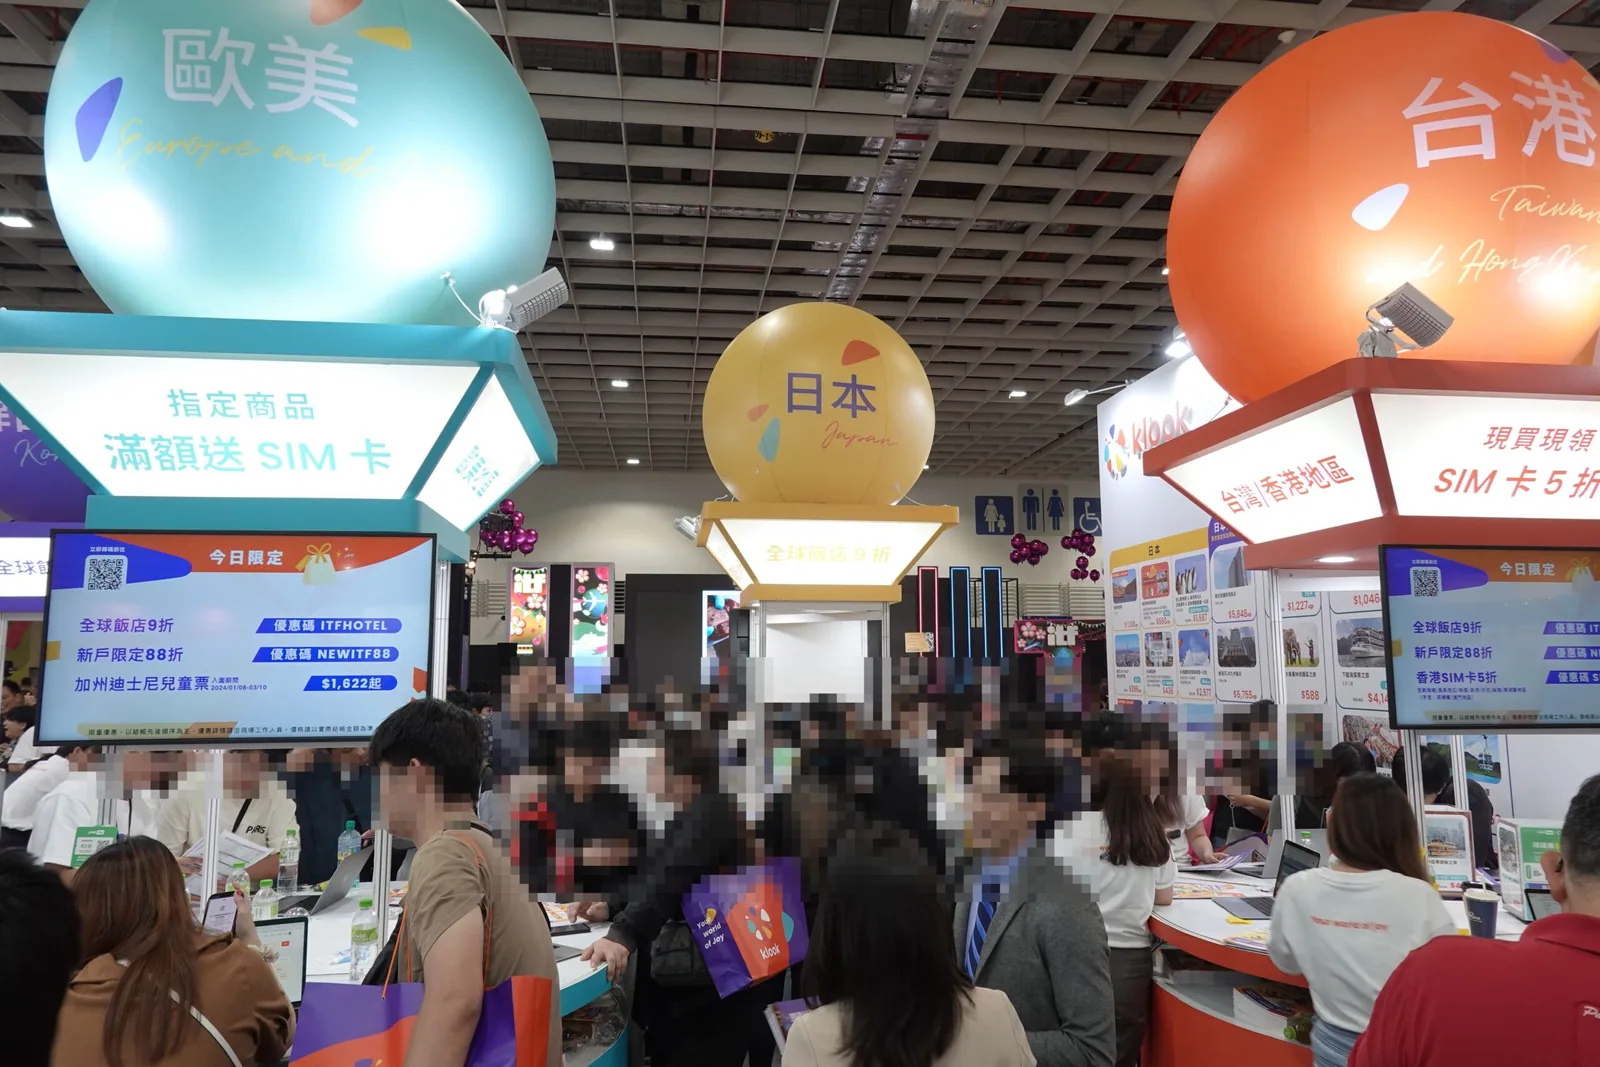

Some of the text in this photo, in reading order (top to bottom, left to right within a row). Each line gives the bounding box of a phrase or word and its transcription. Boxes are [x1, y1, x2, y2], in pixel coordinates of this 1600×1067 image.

[162, 27, 359, 129] 歐美
[1402, 71, 1598, 169] 台港
[115, 116, 263, 171] Europe
[272, 144, 381, 179] and
[787, 373, 877, 419] 日本
[166, 388, 315, 421] 指定商品
[821, 420, 898, 449] Japan
[1482, 427, 1598, 452] 現買現領
[14, 439, 60, 468] Kor
[103, 433, 391, 475] 滿額送 SIM 卡
[1434, 465, 1600, 499] SIM 卡 5 折
[209, 549, 284, 566] 今日限定
[1148, 545, 1161, 556] 日本
[1499, 562, 1556, 577] 今日限定
[79, 618, 175, 634] 全球飯店9折
[274, 619, 388, 632] 優惠碼 ITFHOTEL
[1413, 621, 1482, 634] 全球飯店9折
[76, 647, 184, 663] 新戶限定88折
[271, 648, 391, 661] 優惠碼 NEWITF88
[1414, 646, 1493, 660] 新戶限定88折
[74, 676, 210, 692] 加州迪士尼兒童票
[321, 677, 382, 691] $1,622起
[1416, 671, 1498, 685] 香港SIM卡5折
[696, 917, 712, 930] Your
[702, 922, 722, 938] world
[704, 939, 712, 950] of
[759, 943, 781, 960] klook
